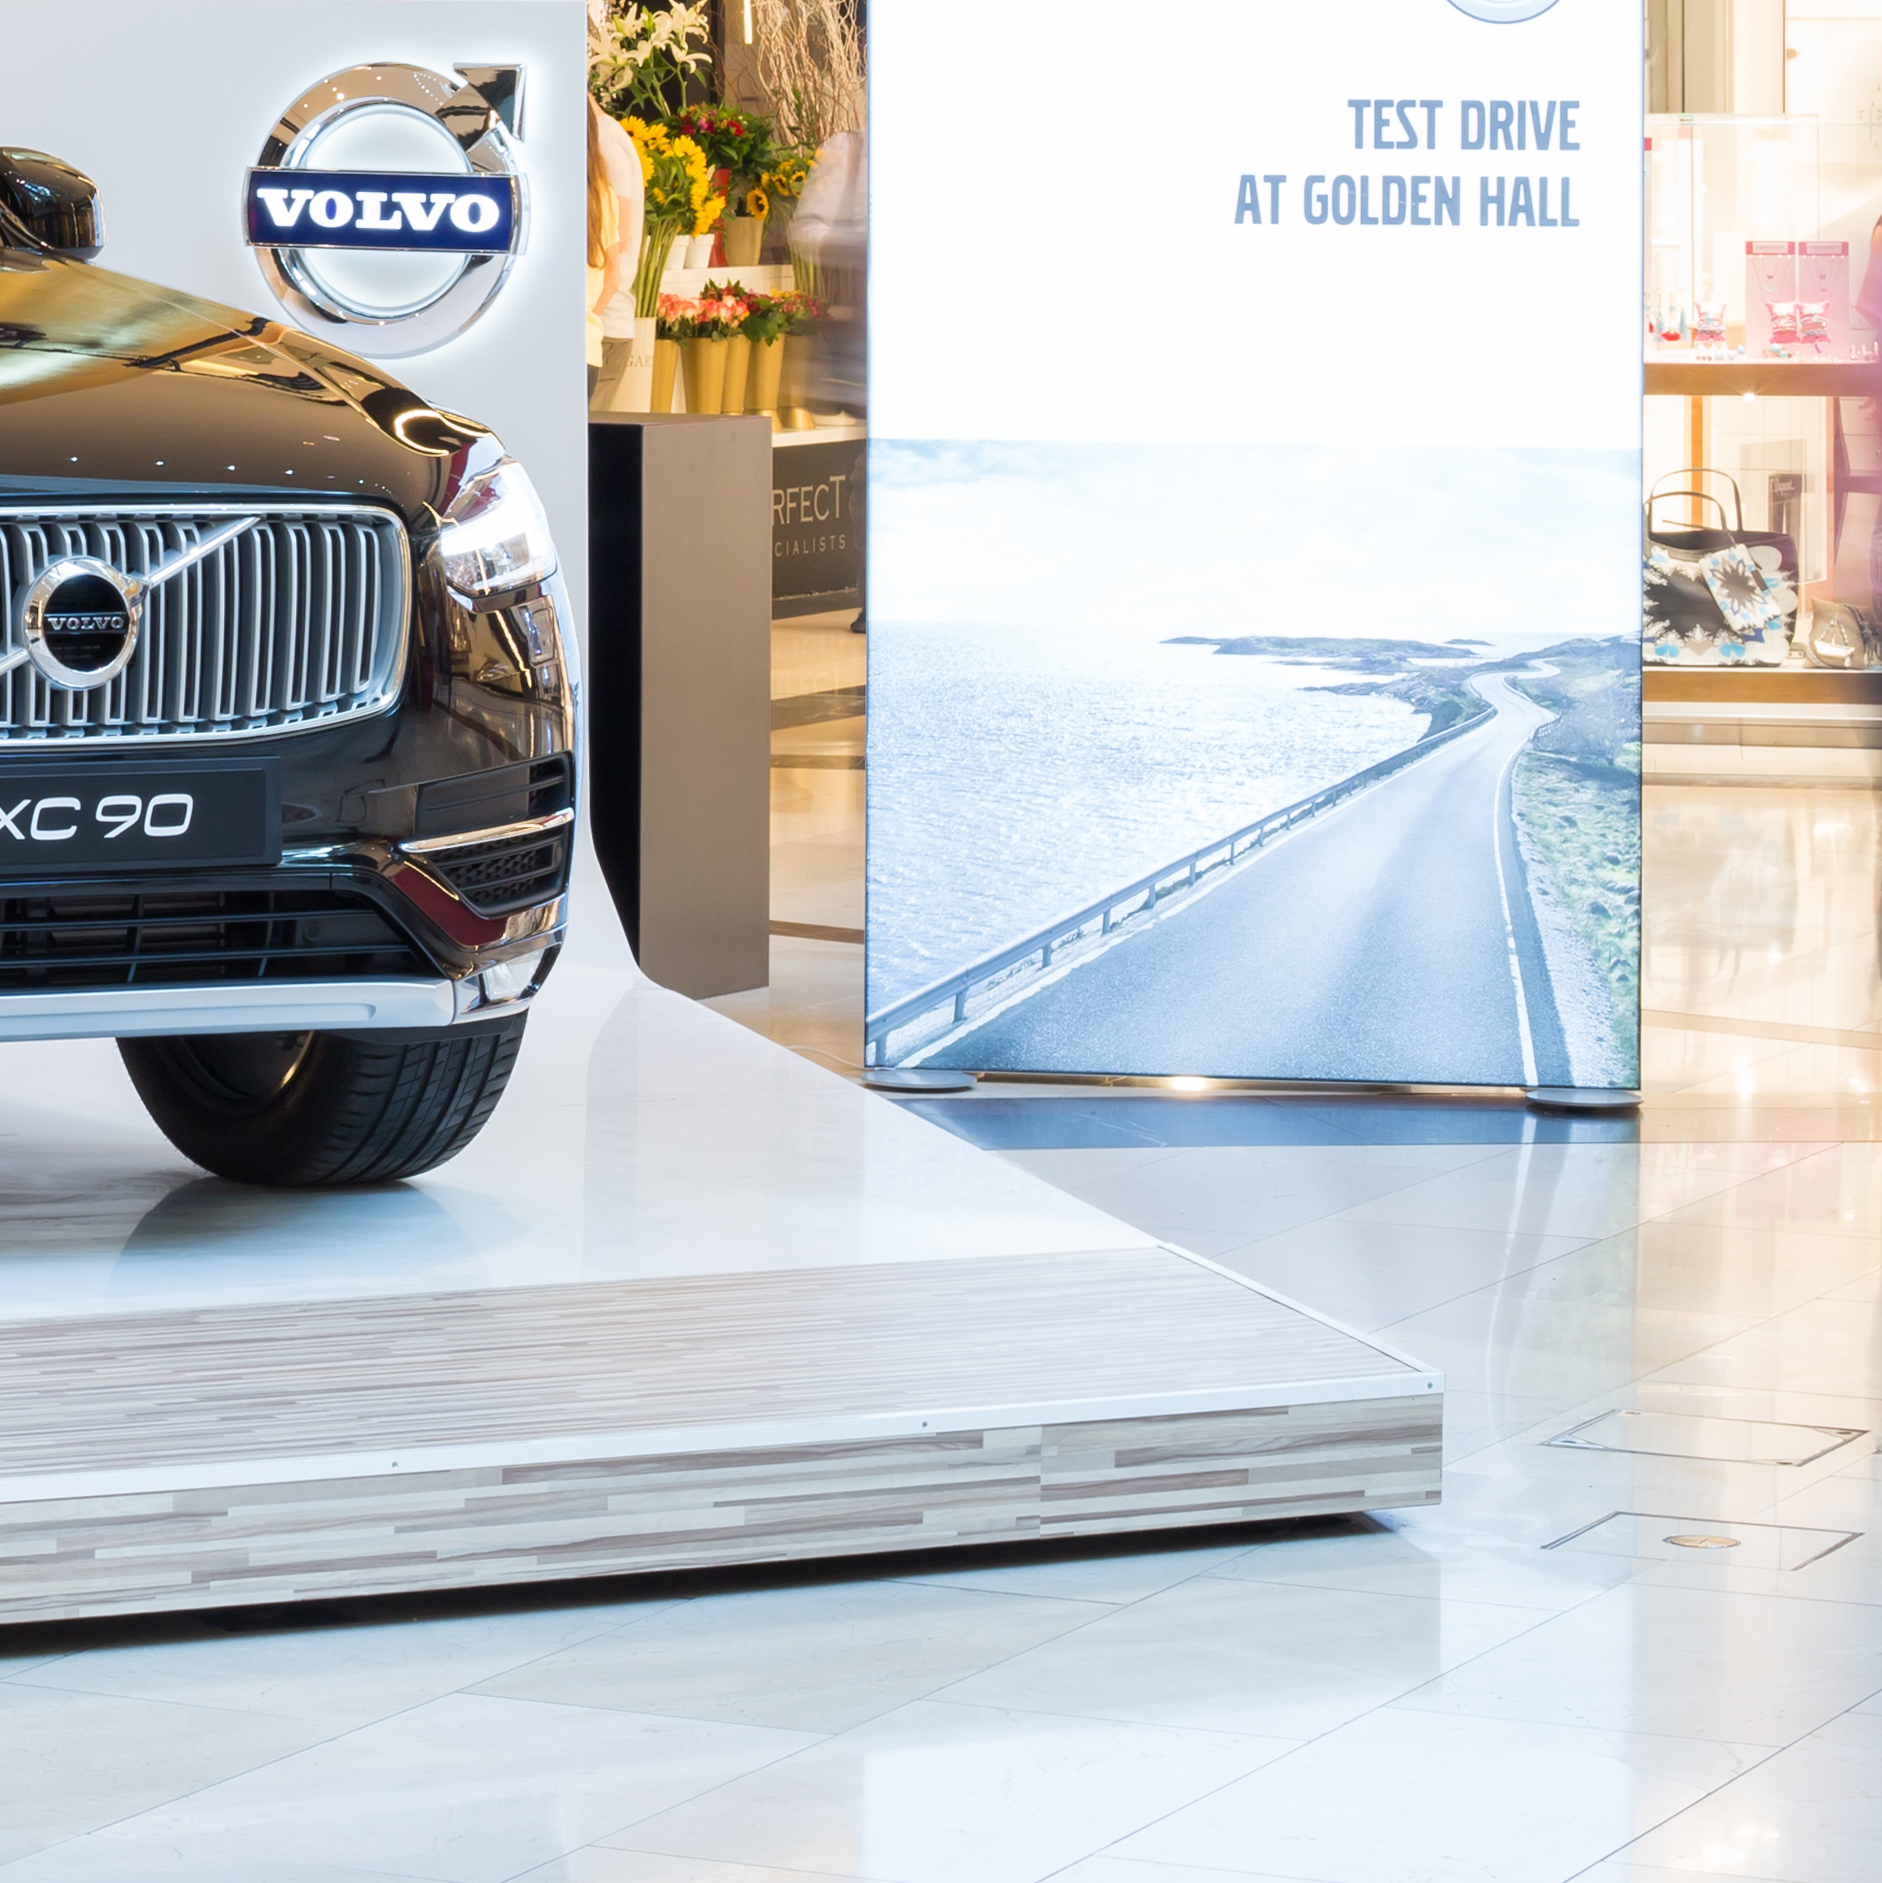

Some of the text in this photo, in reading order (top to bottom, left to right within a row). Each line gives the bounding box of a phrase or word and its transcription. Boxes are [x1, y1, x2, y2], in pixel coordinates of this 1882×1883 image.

[1347, 98, 1581, 151] TEST DRIVE
[256, 188, 501, 234] VOLVO
[1234, 173, 1580, 227] AT GOLDEN HALL
[47, 616, 125, 631] VOLVO
